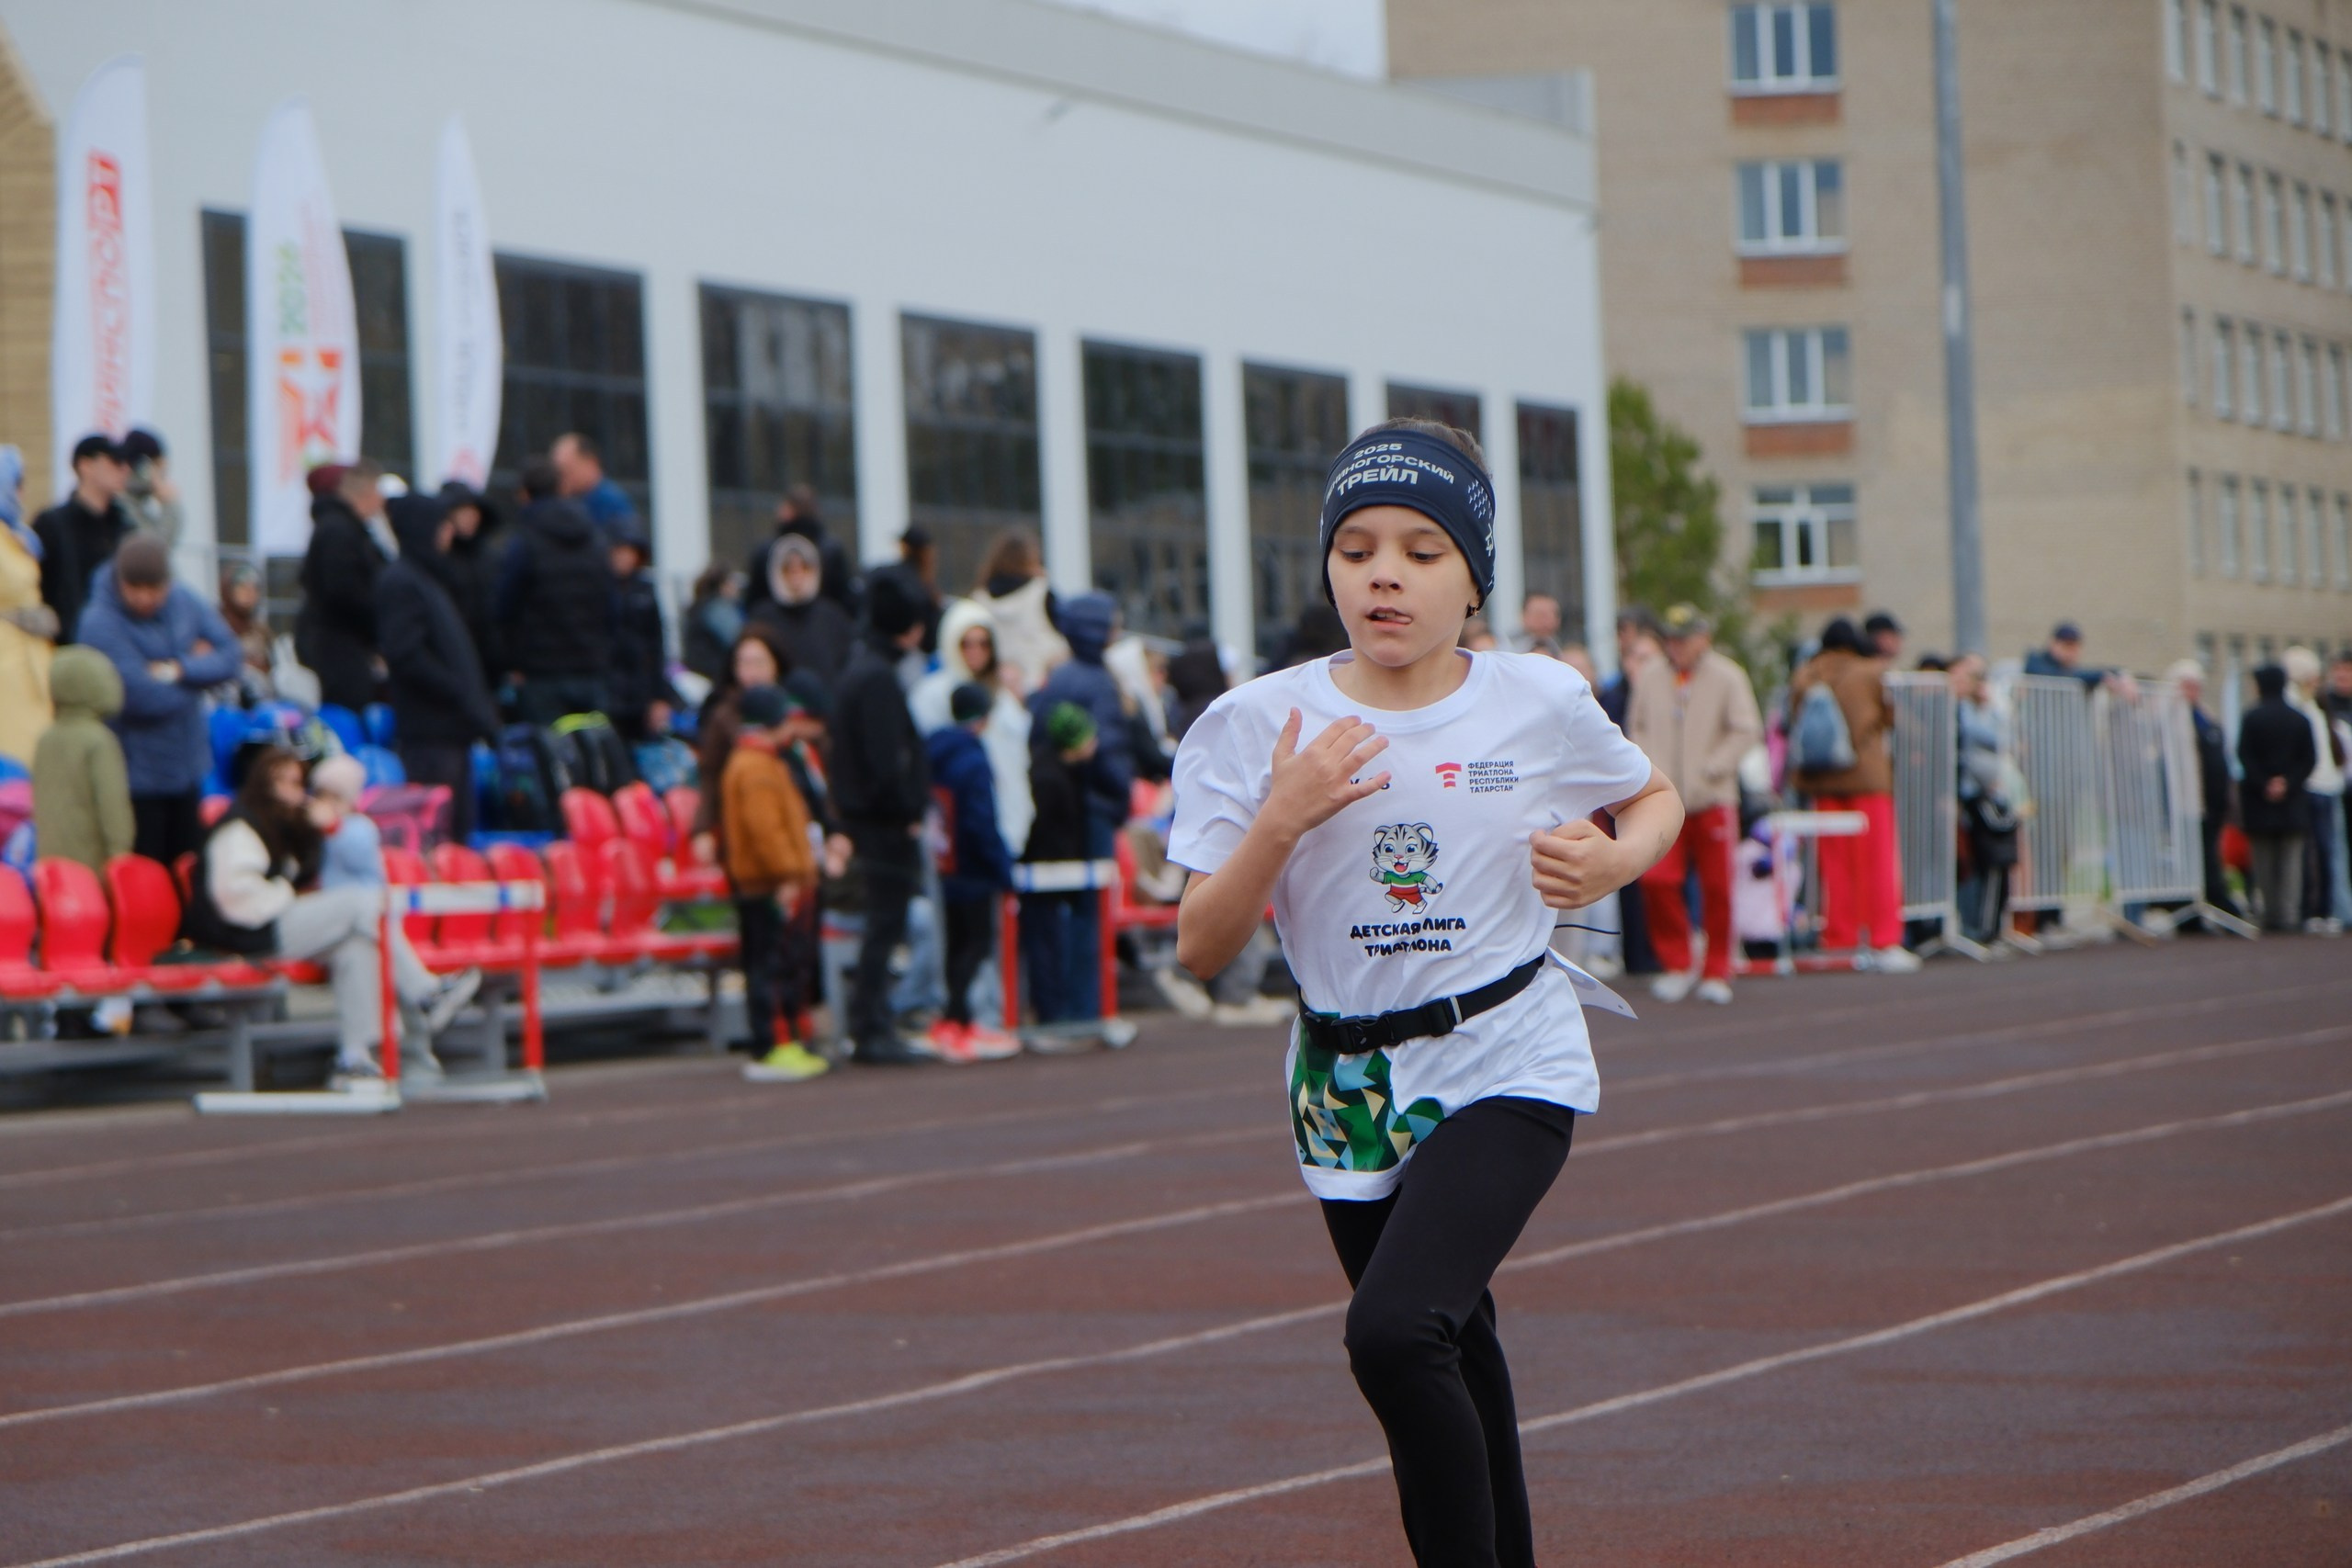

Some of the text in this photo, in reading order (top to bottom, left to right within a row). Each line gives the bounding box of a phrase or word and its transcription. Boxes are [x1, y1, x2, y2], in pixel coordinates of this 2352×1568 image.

[1353, 443, 1403, 460] 2025
[1338, 464, 1419, 497] ТРЕЙЛ
[1467, 761, 1514, 770] ФЕДЕРАЦИЯ
[1468, 769, 1514, 777] ТРИАТЛОНА
[1469, 776, 1519, 785] РЕСПУБЛИКИ
[1469, 784, 1514, 794] ТАТАРСТАН
[1350, 918, 1466, 940] ДЕТСКАЯ ЛИГА
[1364, 938, 1452, 957] ТРИАТЛОНА
